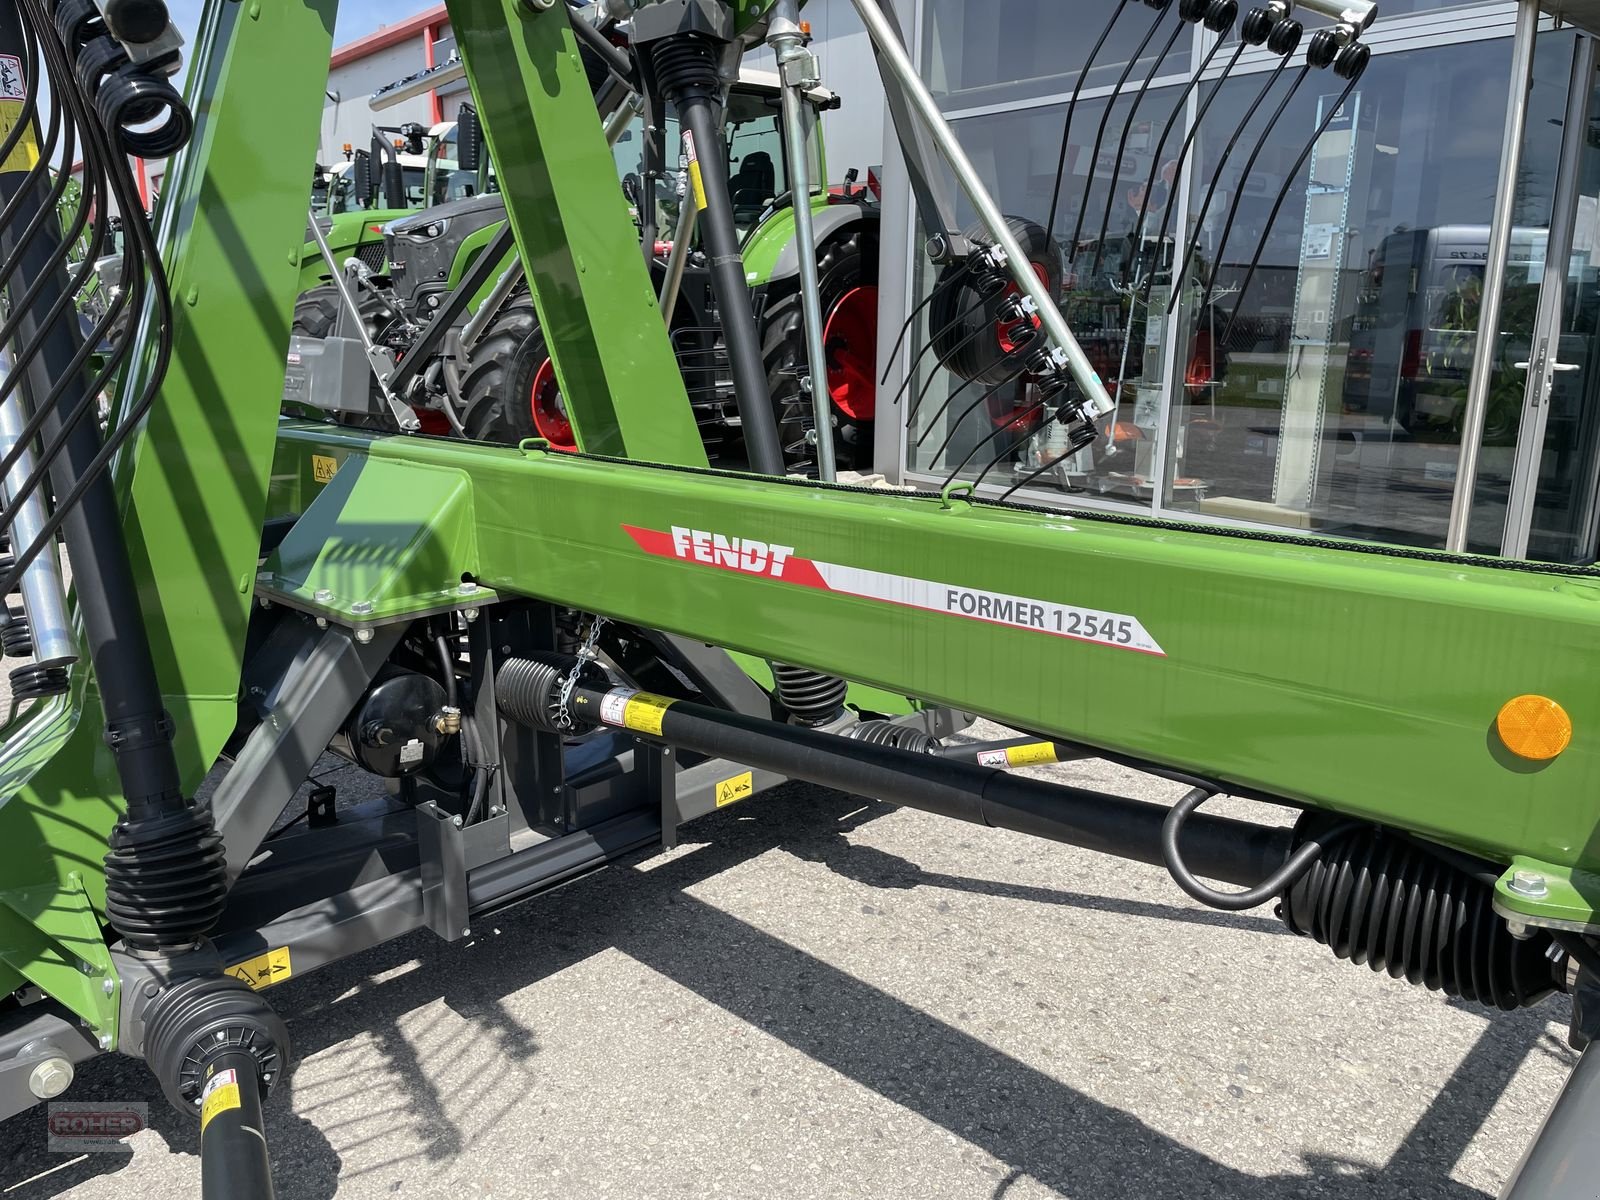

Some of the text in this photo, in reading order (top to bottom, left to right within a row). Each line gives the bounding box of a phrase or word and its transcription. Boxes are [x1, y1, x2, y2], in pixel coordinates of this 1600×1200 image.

[671, 525, 794, 577] FENDT
[947, 589, 1132, 644] FORMER 12545
